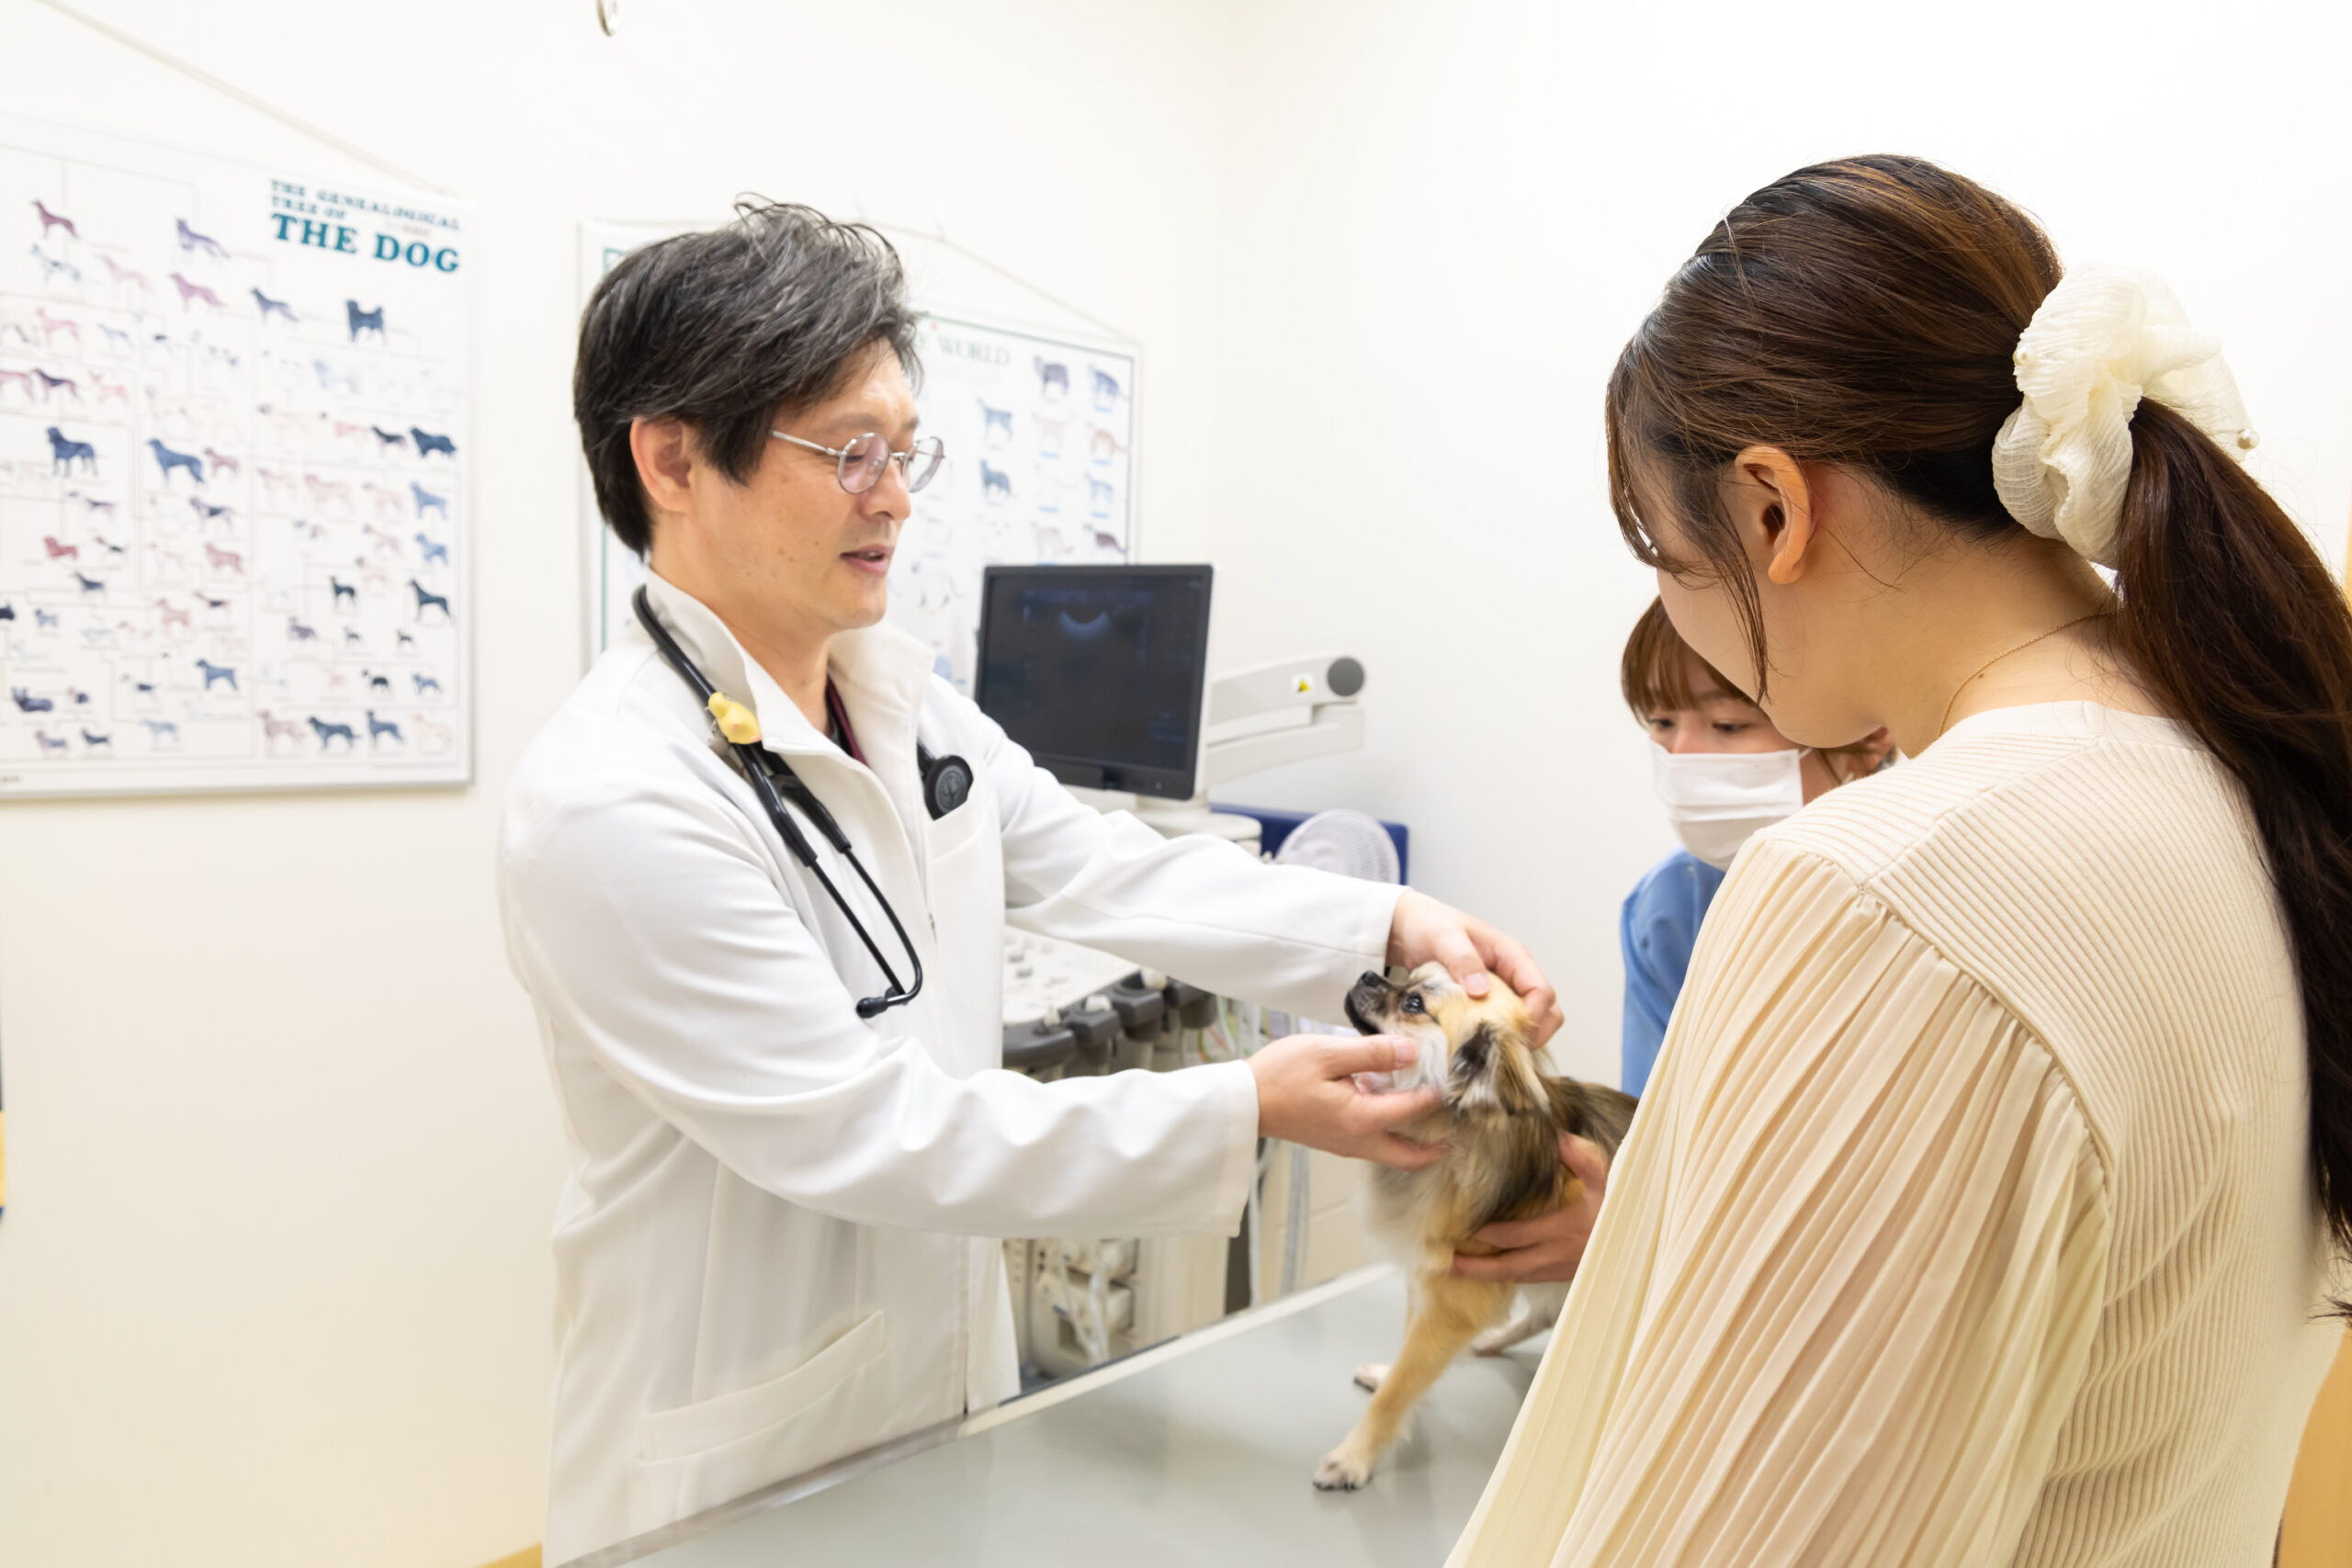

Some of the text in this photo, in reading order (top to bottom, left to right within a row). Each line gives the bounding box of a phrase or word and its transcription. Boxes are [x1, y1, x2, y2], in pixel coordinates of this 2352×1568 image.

[271, 180, 306, 197] THE
[316, 190, 460, 231] GENEALOGICAL
[271, 196, 346, 220] TREE OF
[271, 213, 358, 254] THE
[373, 232, 459, 273] DOG
[939, 336, 1011, 367] WORLD
